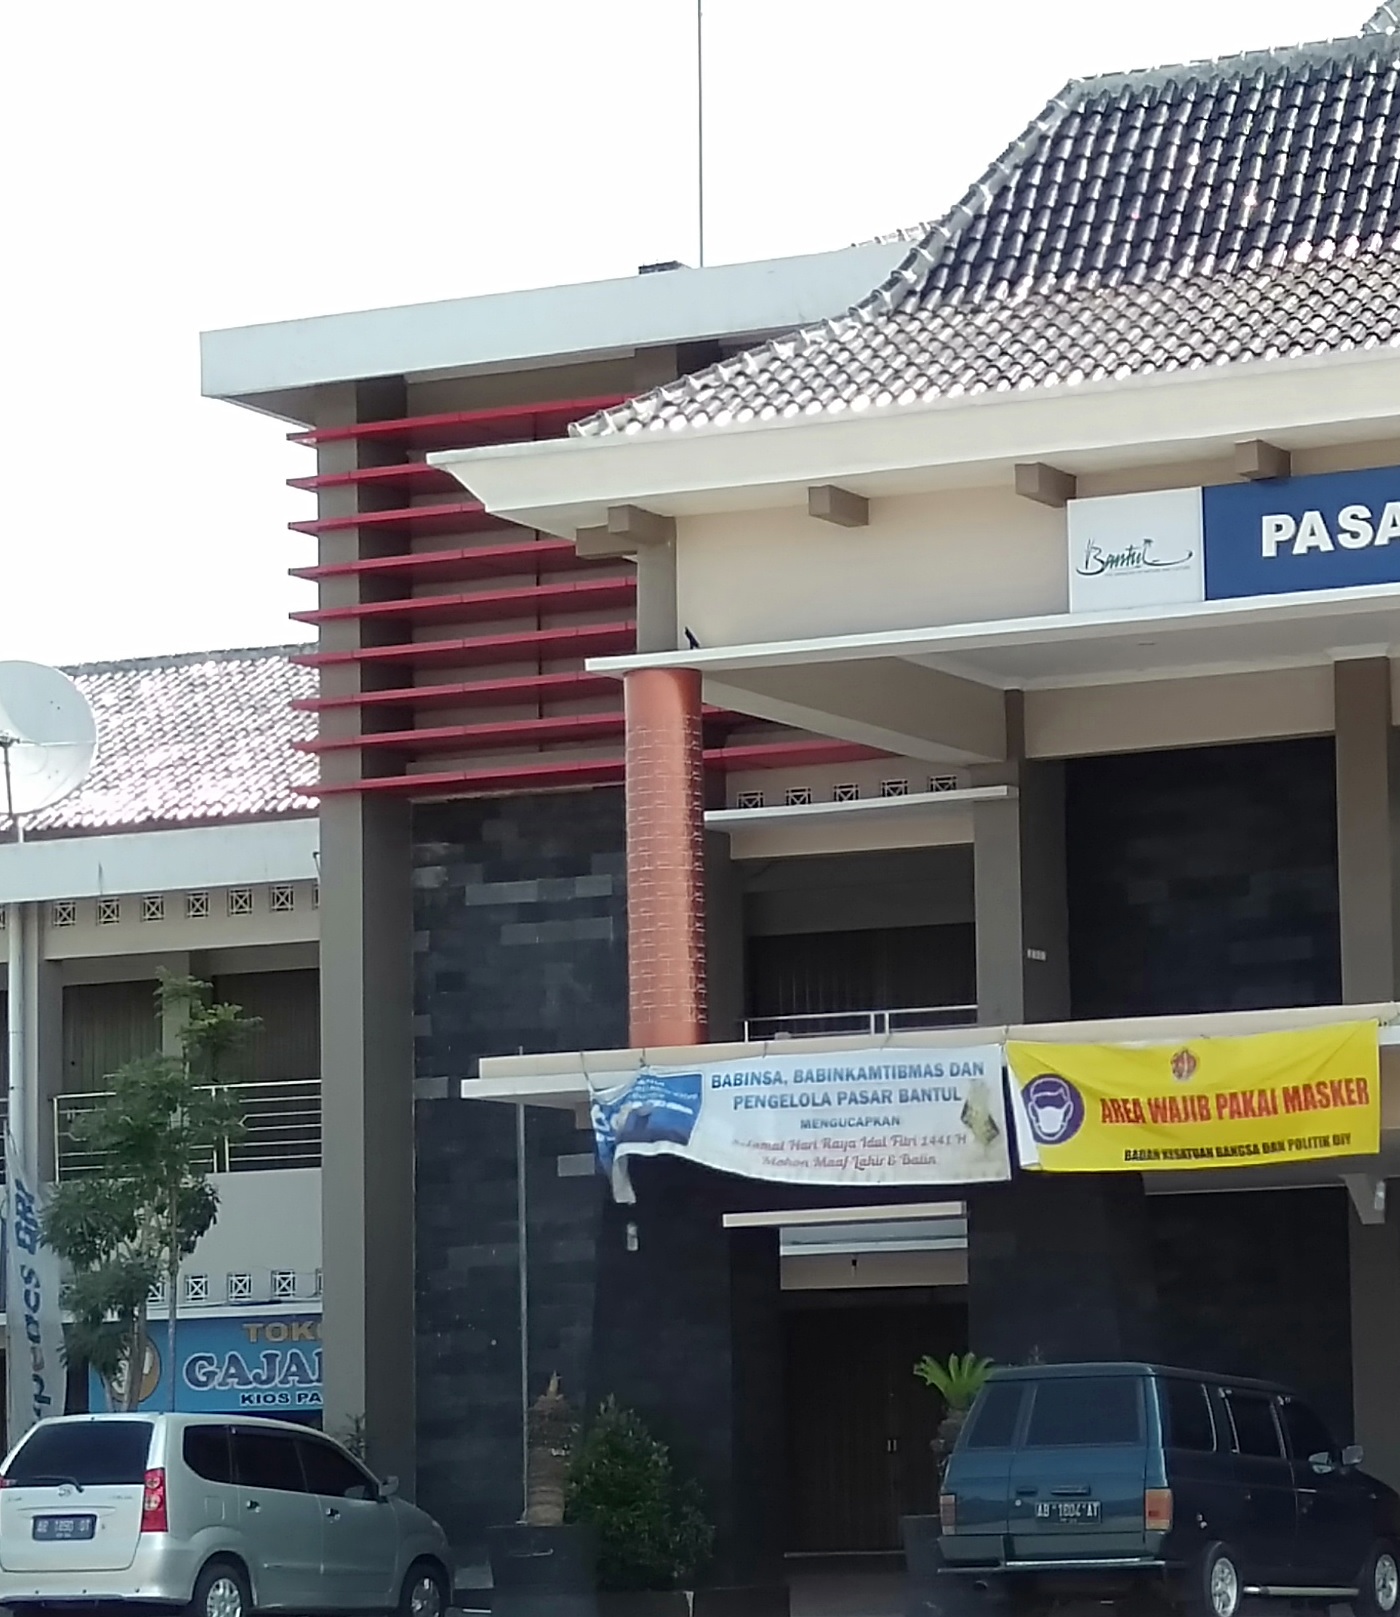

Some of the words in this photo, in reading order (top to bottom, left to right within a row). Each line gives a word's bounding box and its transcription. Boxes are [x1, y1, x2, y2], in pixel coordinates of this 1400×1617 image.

[711, 1071, 789, 1089] BABINSA,
[793, 1063, 945, 1084] BABINKAMTIBMAS
[949, 1062, 985, 1078] DAN
[733, 1092, 832, 1110] PENGELOLA
[837, 1089, 893, 1106] PASAR
[898, 1086, 963, 1104] BANTUL
[1100, 1097, 1147, 1124] AREA
[1147, 1094, 1212, 1124] WAJIB
[1215, 1088, 1279, 1121] PAKAI
[1282, 1077, 1371, 1115] MASKER
[800, 1115, 901, 1130] MENGUCAPKAN
[820, 1137, 857, 1153] Raya
[920, 1133, 952, 1146] 1441
[1216, 1143, 1261, 1159] BANGSA
[1287, 1135, 1331, 1151] POLITIK
[242, 1320, 322, 1343] TOK
[240, 1392, 290, 1406] KIOS
[296, 1391, 322, 1405] PA
